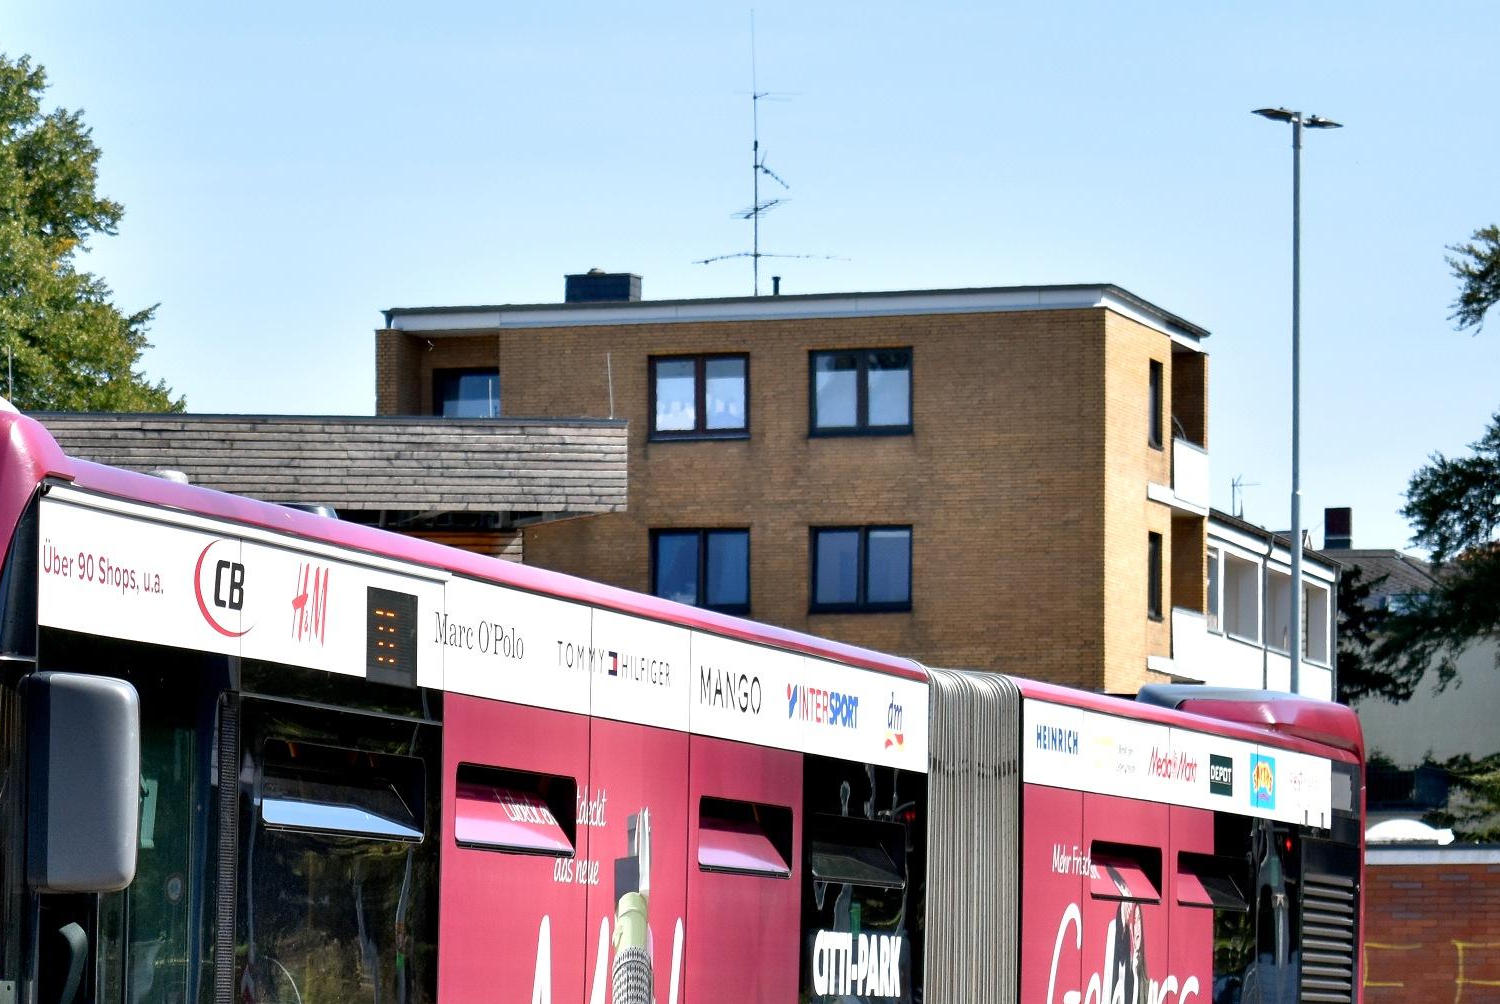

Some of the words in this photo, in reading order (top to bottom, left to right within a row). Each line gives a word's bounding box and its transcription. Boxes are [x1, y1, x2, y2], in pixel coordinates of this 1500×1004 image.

[43, 538, 74, 578] Über
[78, 552, 95, 581] 90
[98, 556, 140, 595] Shops,
[143, 572, 164, 594] u.a.
[214, 559, 245, 611] CB
[292, 562, 329, 648] H&M
[434, 611, 474, 650] Marc
[478, 620, 524, 660] O'Polo
[557, 640, 605, 674] TOMMY
[621, 653, 671, 688] HILFIGER
[700, 665, 762, 716] MANGO
[799, 685, 859, 729] INTERSPORT
[887, 691, 903, 730] dm
[1036, 723, 1079, 756] HEINRICH
[1210, 764, 1232, 783] DEPOT
[553, 857, 574, 884] das
[575, 859, 599, 886] neue
[1052, 843, 1071, 874] Mehr
[813, 929, 902, 997] CITTI-PARK
